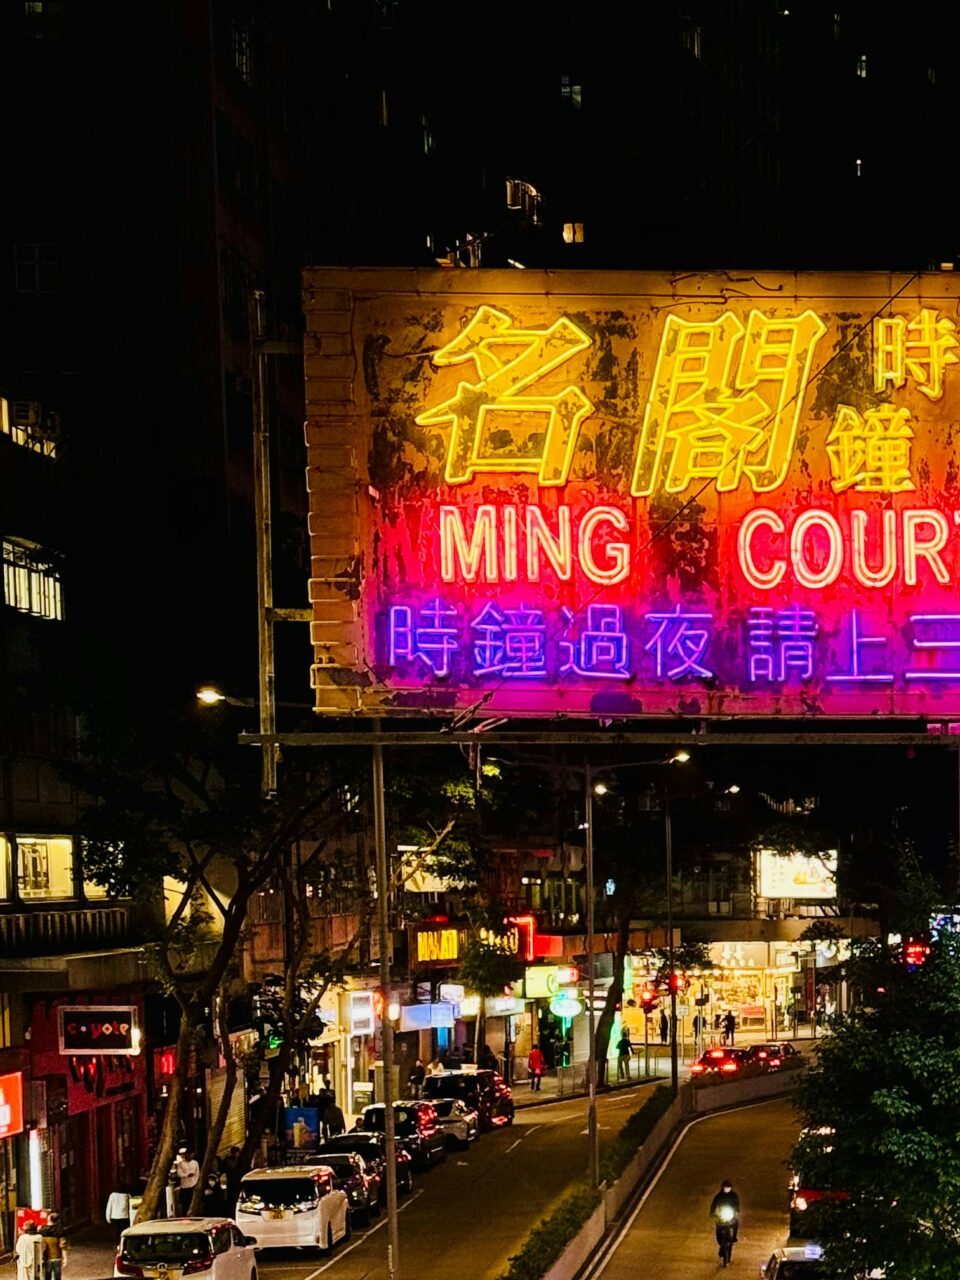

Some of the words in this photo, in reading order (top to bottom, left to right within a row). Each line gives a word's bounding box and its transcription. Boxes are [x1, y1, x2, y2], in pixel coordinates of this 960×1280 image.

[415, 304, 829, 498] 名閣
[439, 505, 631, 586] MING
[387, 598, 714, 680] 時鐘過夜
